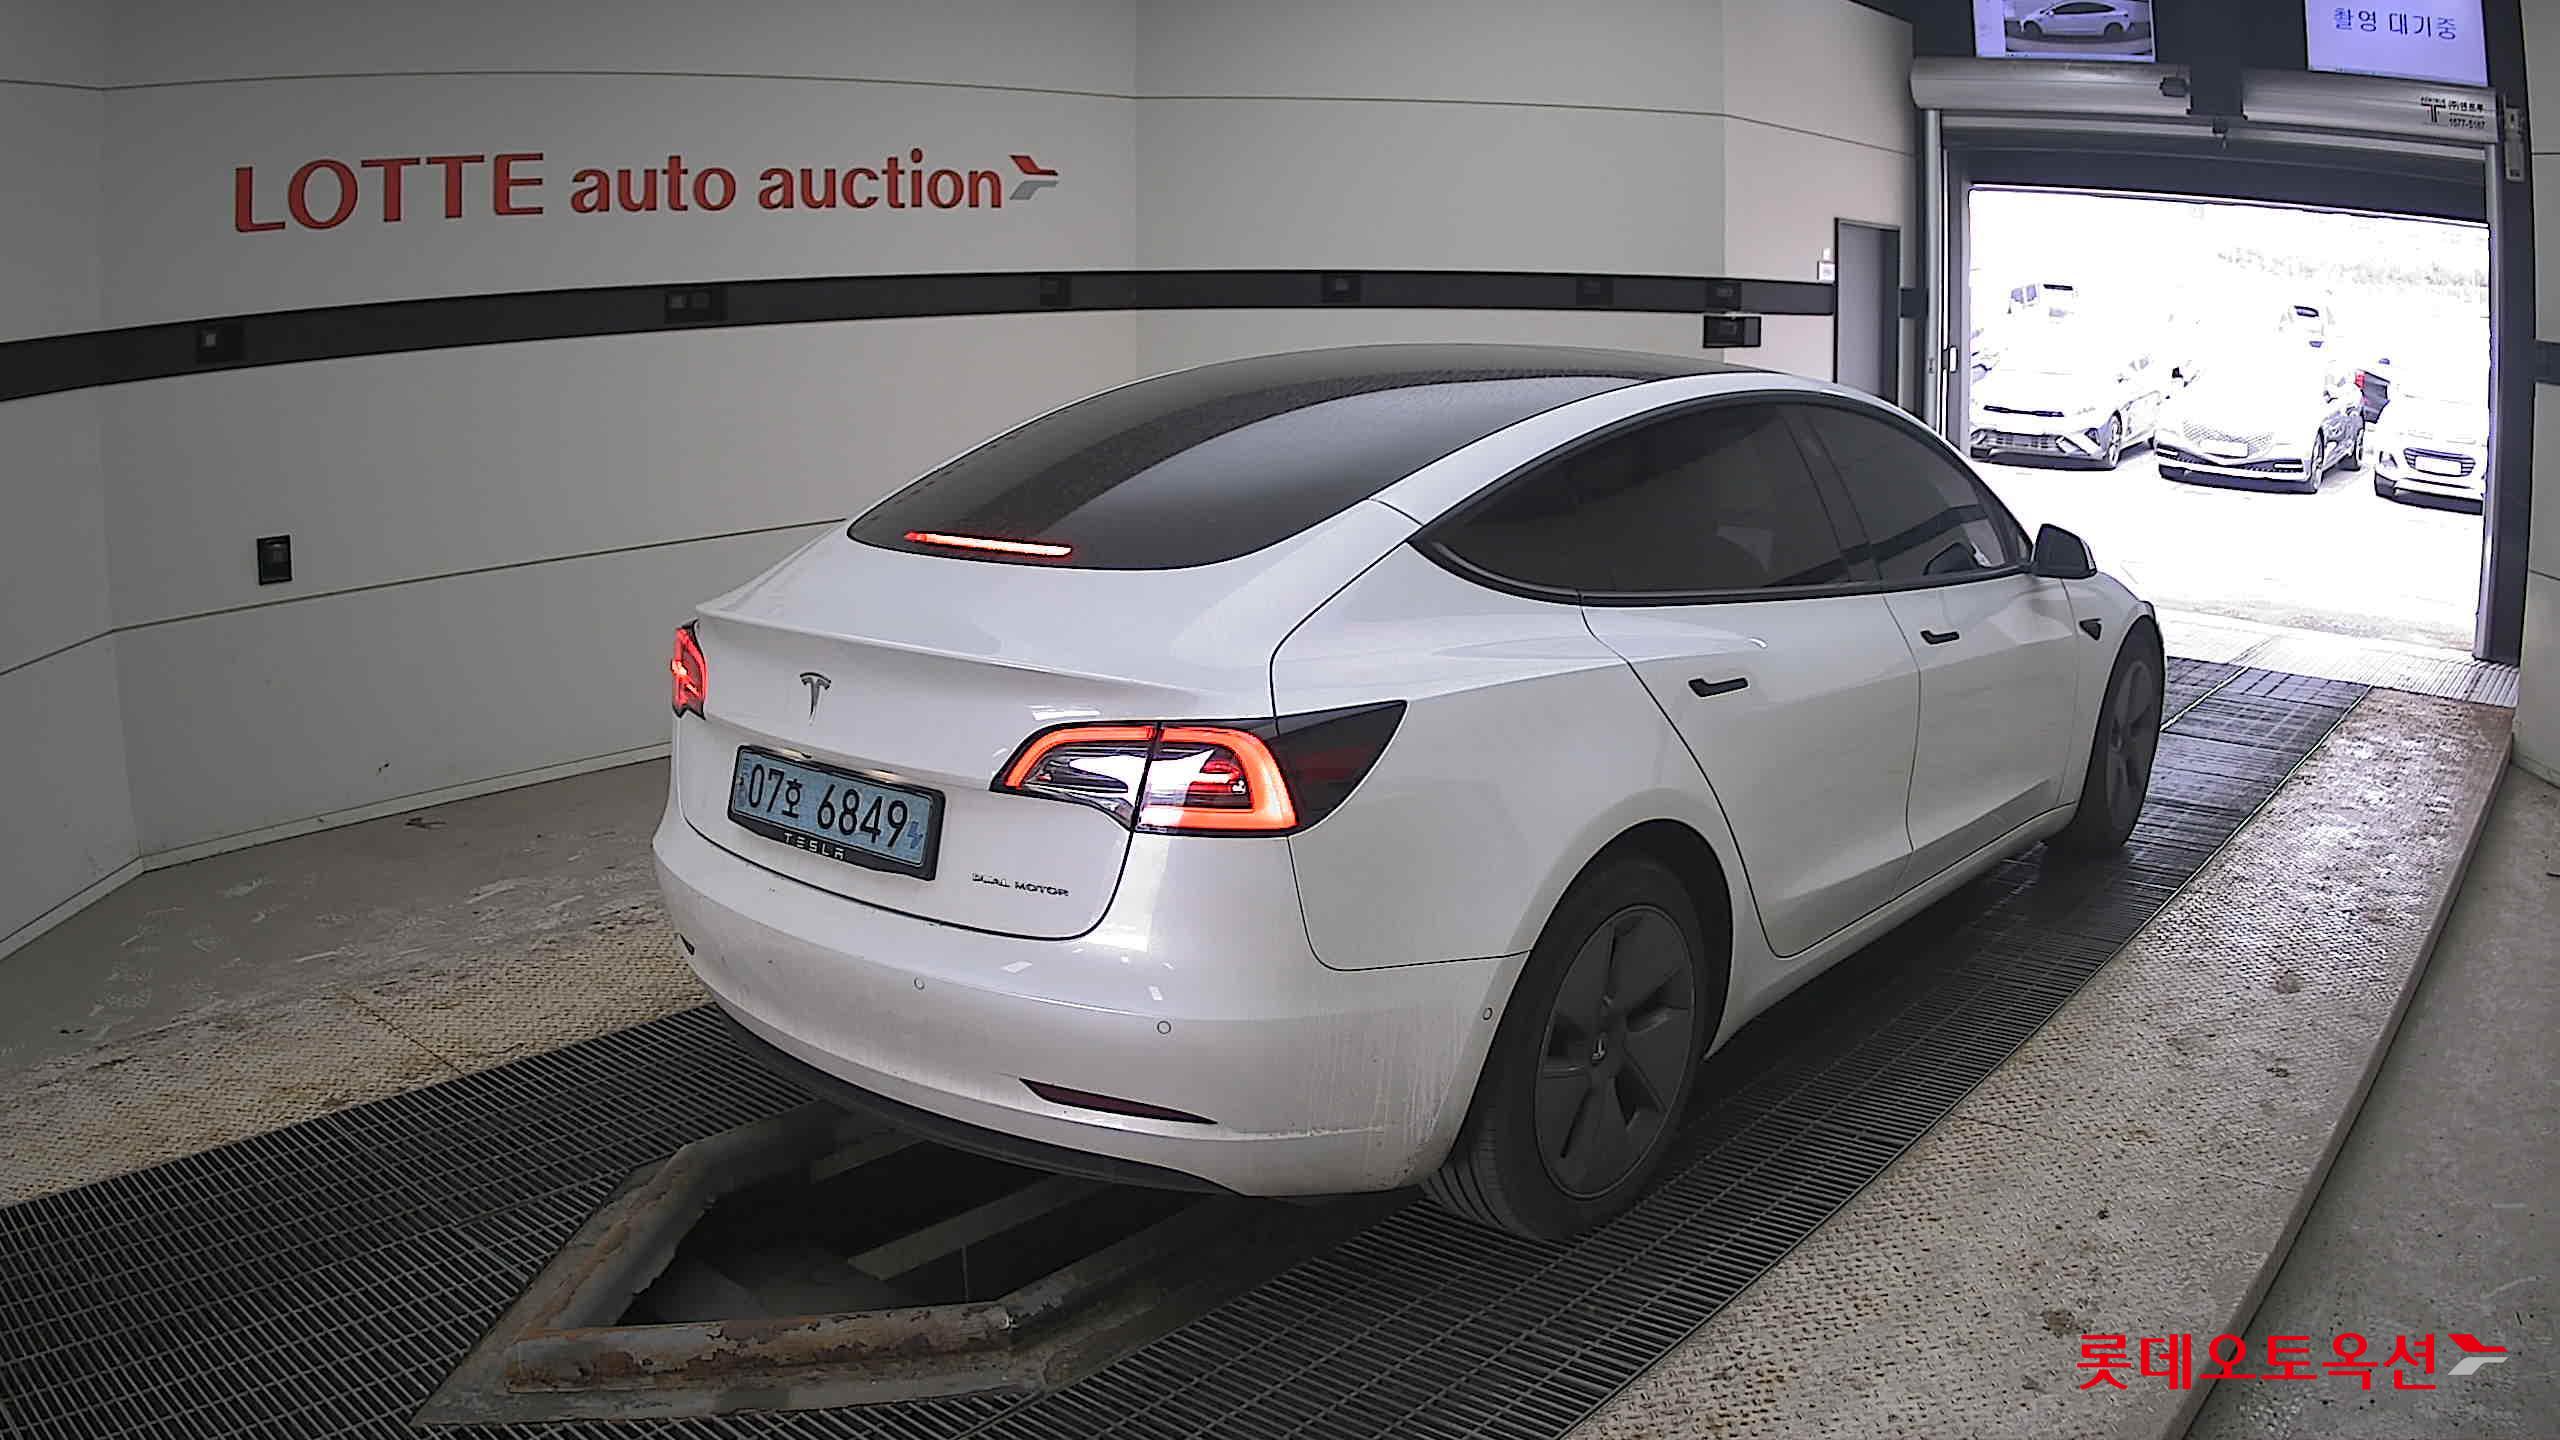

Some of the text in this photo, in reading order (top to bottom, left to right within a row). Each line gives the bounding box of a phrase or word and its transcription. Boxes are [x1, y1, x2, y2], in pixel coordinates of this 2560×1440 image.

[2388, 13, 2457, 40] 대기중
[235, 148, 1002, 232] LOTTE auto auction
[750, 764, 908, 848] 07호 6849
[784, 832, 844, 860] TESLA
[1015, 881, 1069, 896] MOTOR
